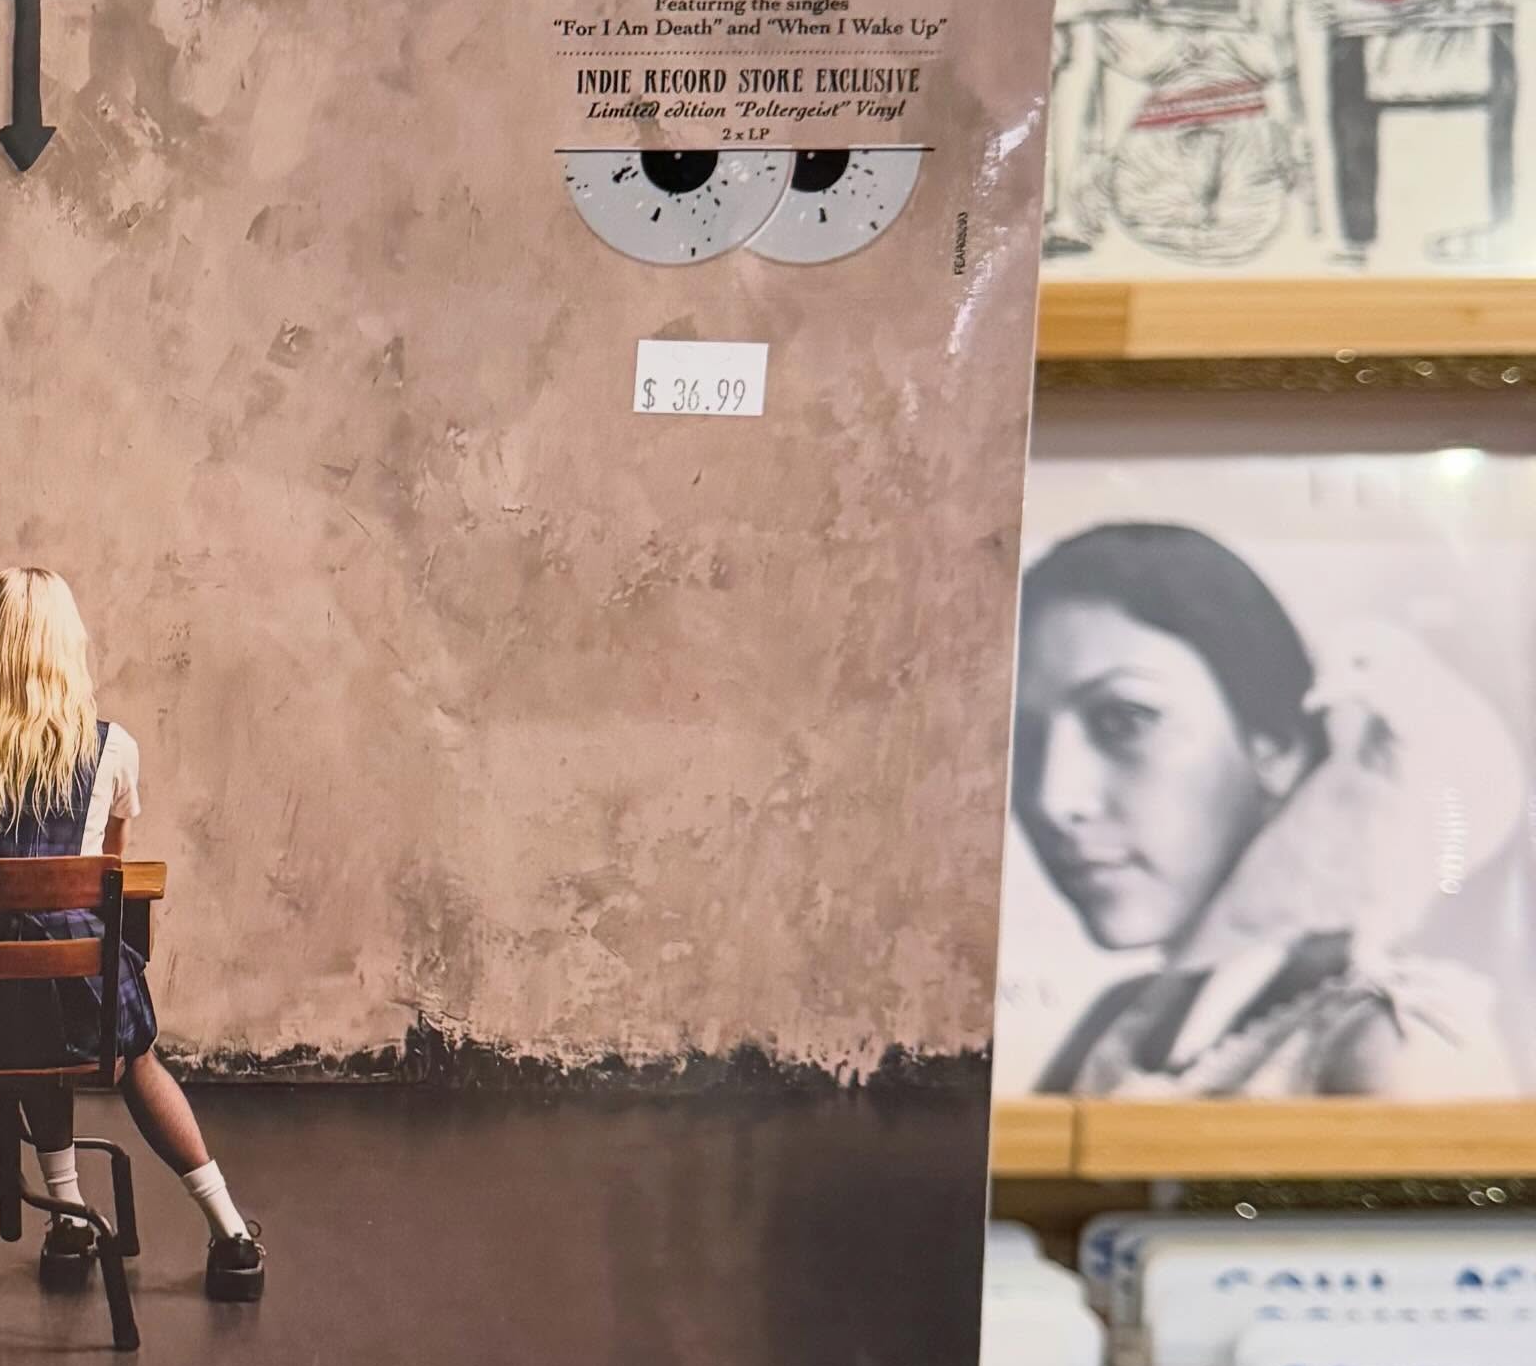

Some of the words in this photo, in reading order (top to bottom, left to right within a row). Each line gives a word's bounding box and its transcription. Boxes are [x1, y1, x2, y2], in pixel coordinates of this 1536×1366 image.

[553, 19, 596, 36] “For
[601, 19, 610, 36] I
[616, 19, 648, 36] Am
[656, 18, 722, 36] Death”
[727, 19, 760, 35] and
[768, 18, 830, 35] “When
[838, 18, 846, 35] I
[852, 18, 903, 35] Wake
[911, 18, 948, 40] Up”
[577, 69, 632, 94] INDIE
[644, 69, 727, 94] RECORD
[738, 68, 804, 93] STORE
[816, 67, 921, 93] EXCLUSIVE
[587, 101, 661, 119] Limited
[664, 101, 727, 118] edition
[735, 99, 851, 122] “Poltergeist”
[856, 99, 907, 122] Vinyl
[722, 128, 732, 141] 2
[735, 131, 744, 141] x
[748, 128, 770, 141] LP
[642, 378, 657, 411] $
[672, 378, 747, 412] 36.99
